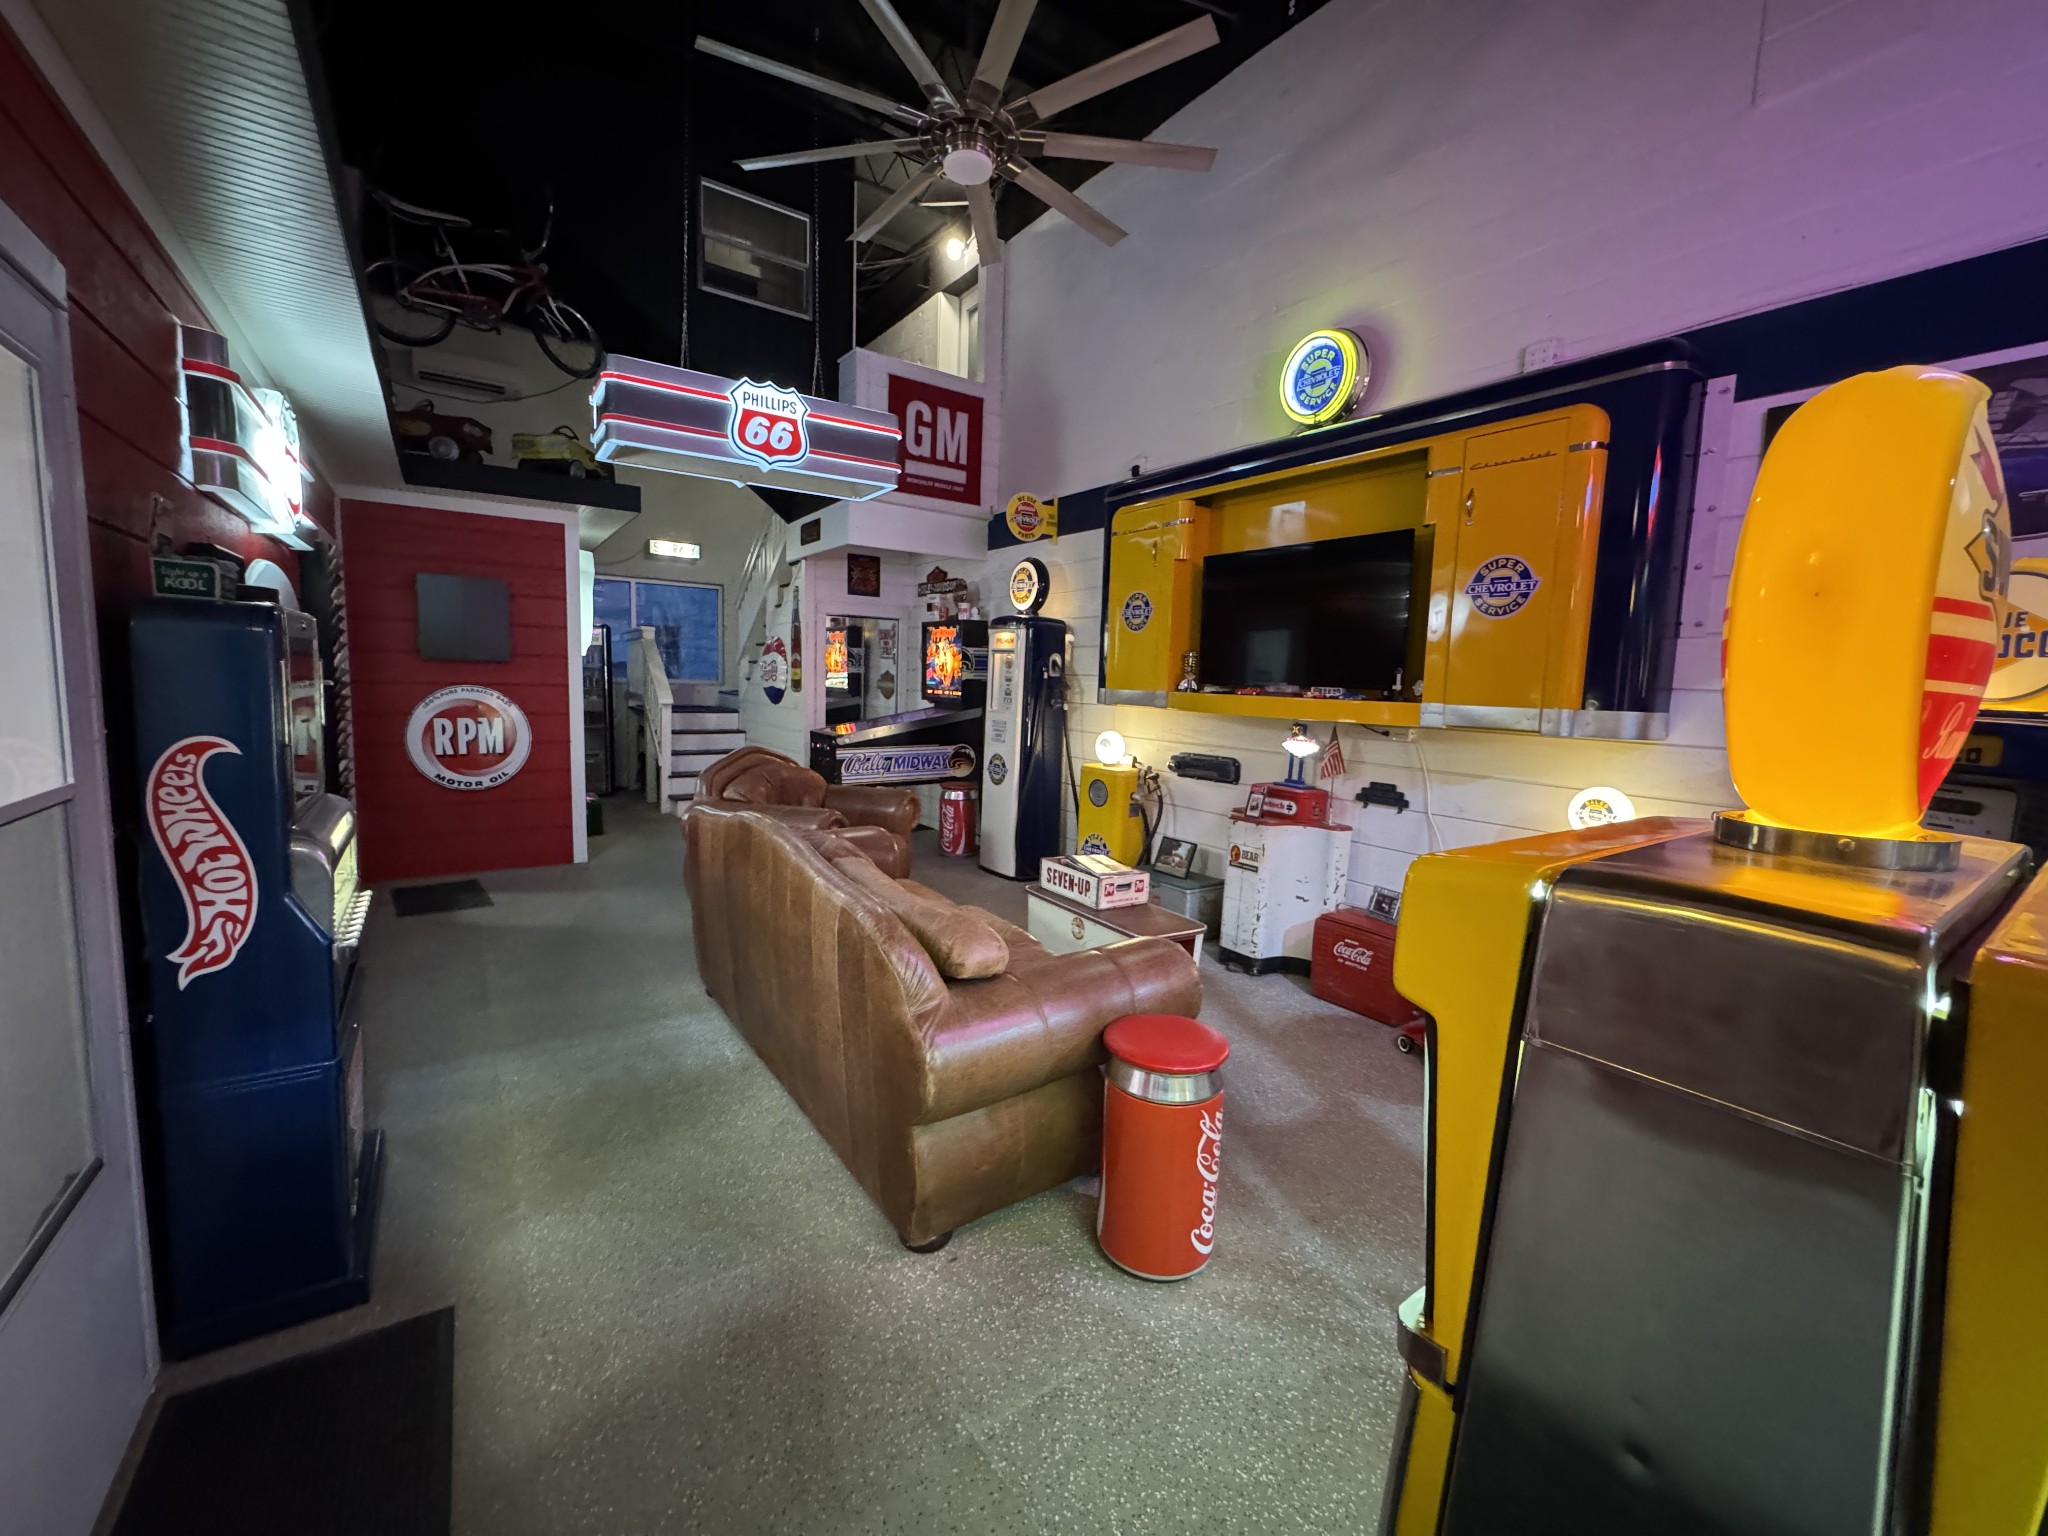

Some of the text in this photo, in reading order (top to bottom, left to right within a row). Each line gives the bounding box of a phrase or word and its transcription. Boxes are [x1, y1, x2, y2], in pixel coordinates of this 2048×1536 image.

[1301, 349, 1335, 371] SUPER
[1299, 368, 1340, 387] CHEVROLET
[743, 391, 797, 415] PHILLIPS
[1300, 382, 1336, 405] SERVICE
[745, 416, 794, 450] 66
[905, 400, 969, 465] GM
[1480, 558, 1525, 577] SUPER
[164, 577, 207, 590] KOOL
[1467, 581, 1537, 594] CHEVROLET
[1475, 596, 1526, 615] SERVICE
[440, 688, 459, 698] PURE
[433, 717, 505, 756] RPM
[844, 752, 949, 776] Bally MIDWAY
[434, 771, 509, 788] MOTOR OIL
[1241, 851, 1259, 862] BEAR
[1046, 867, 1091, 897] SEVEN-UP
[1190, 1108, 1224, 1255] Coca-Cola
